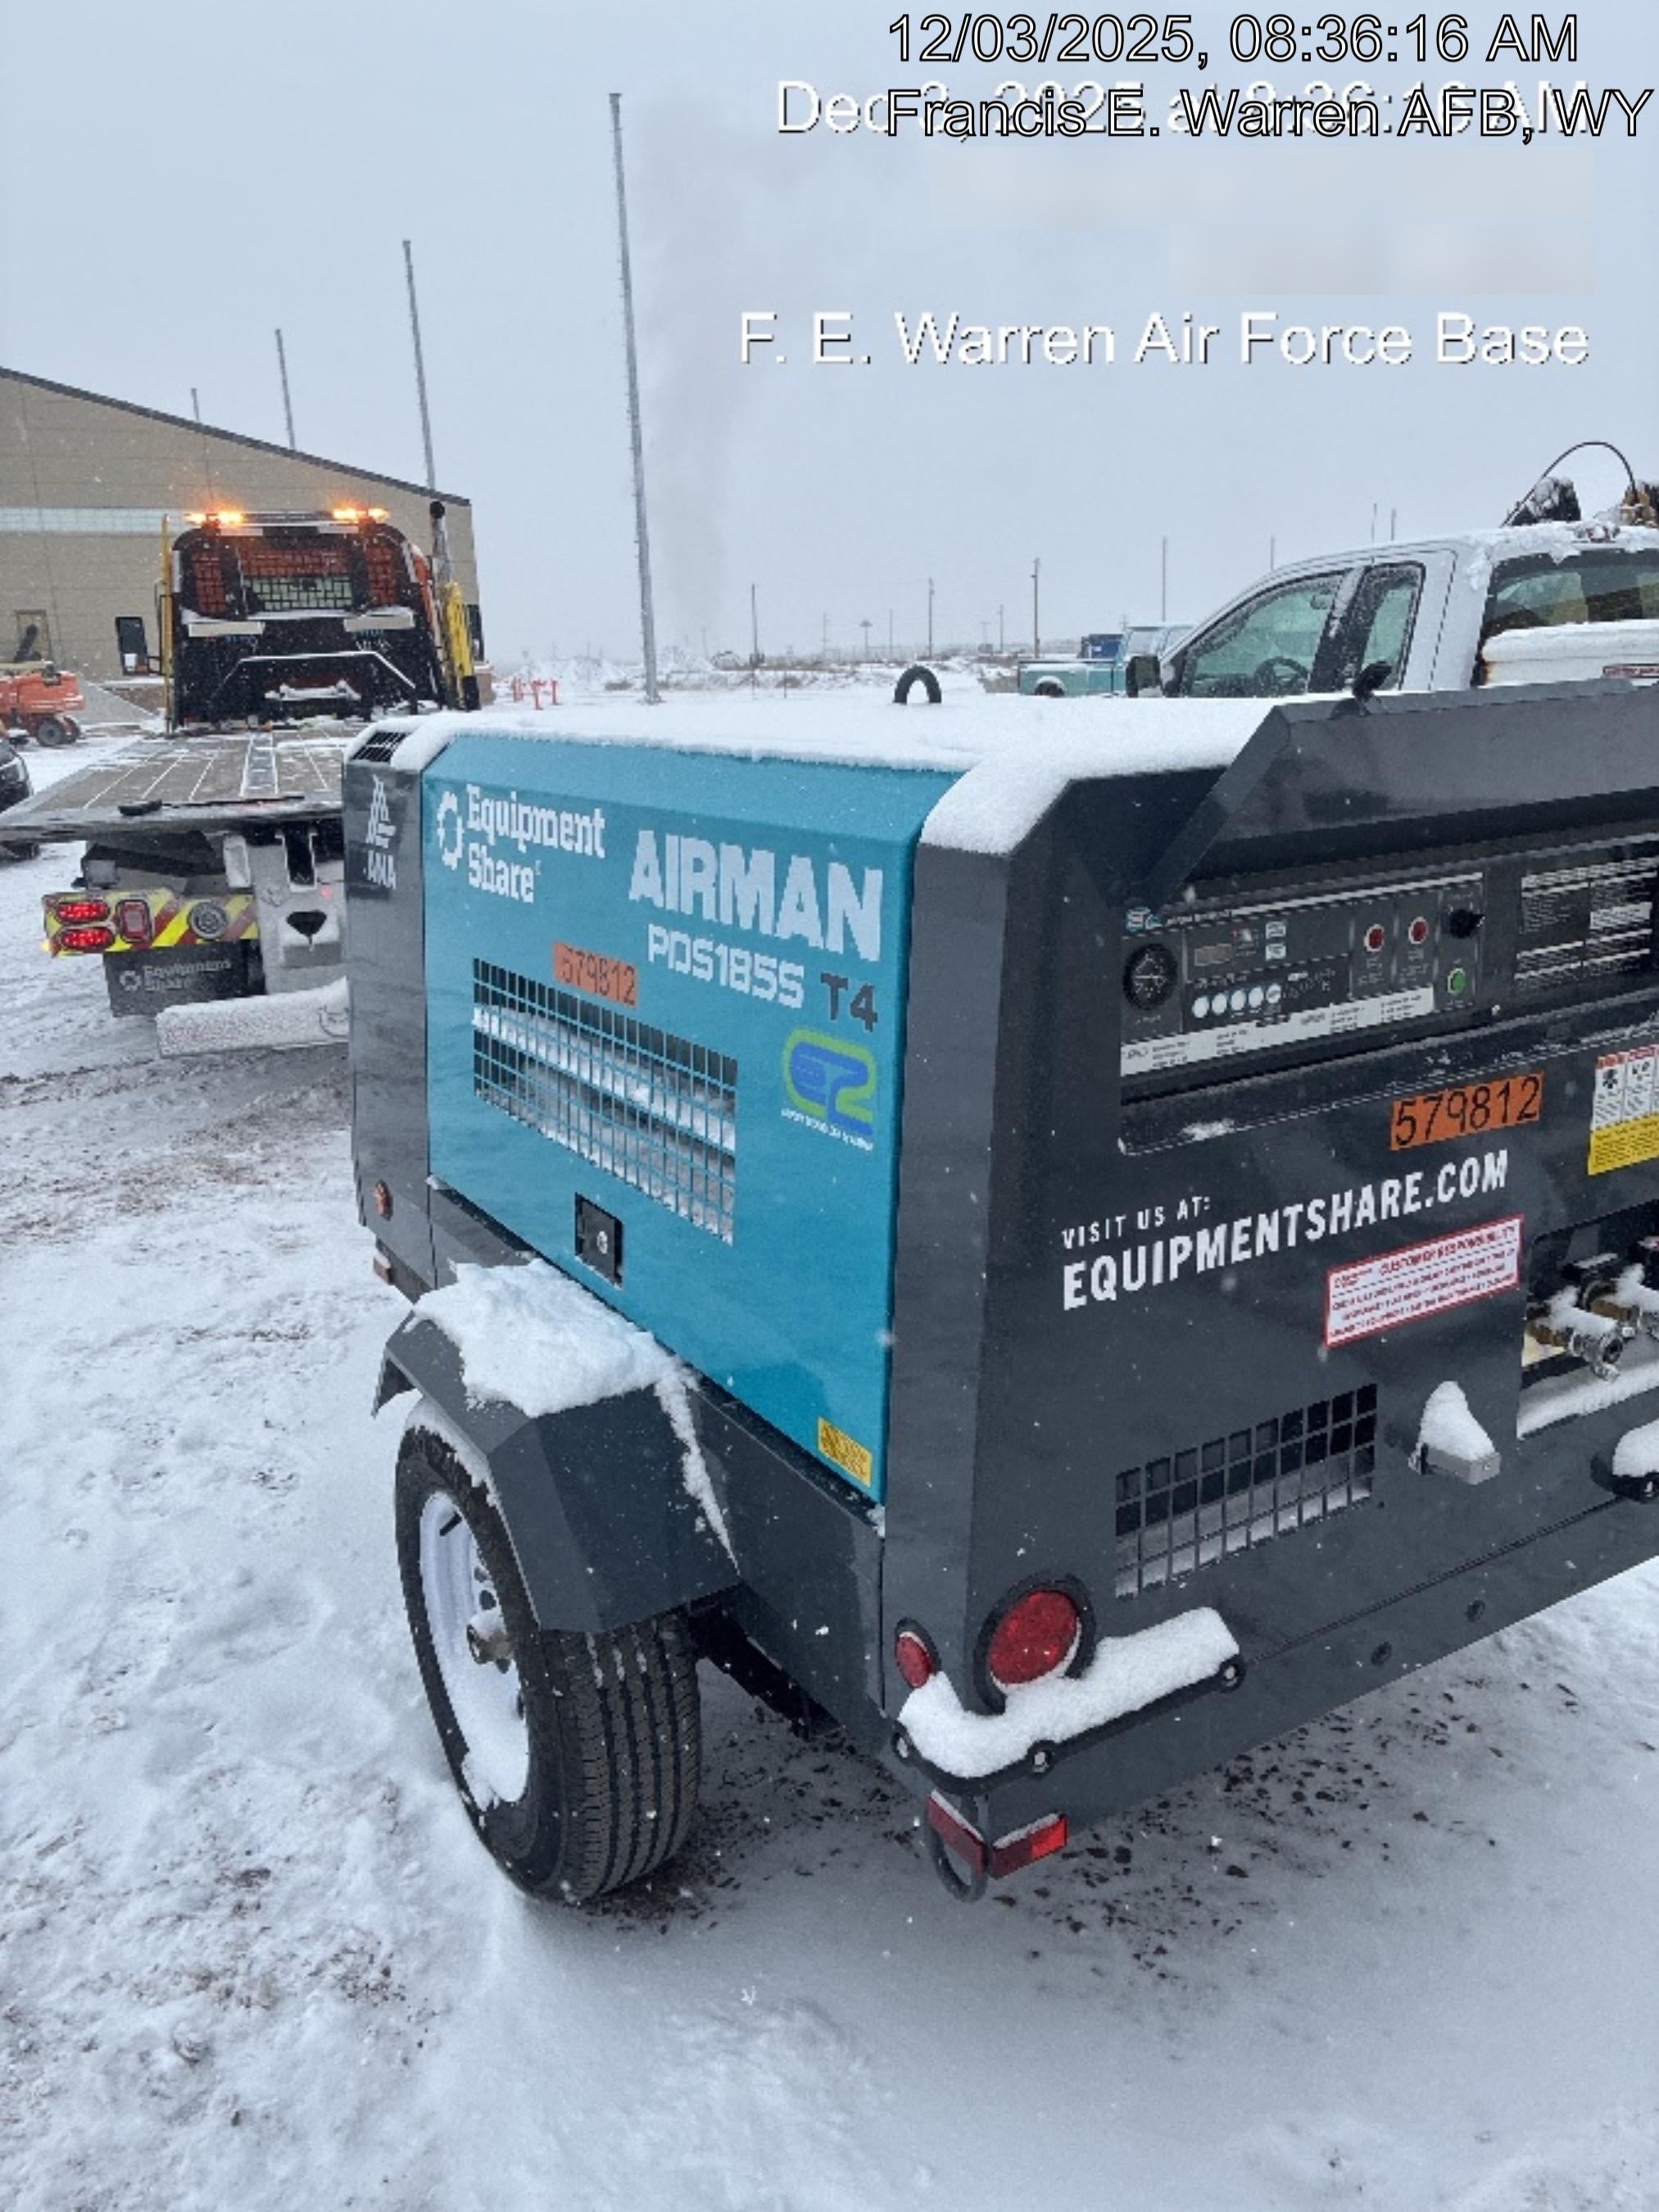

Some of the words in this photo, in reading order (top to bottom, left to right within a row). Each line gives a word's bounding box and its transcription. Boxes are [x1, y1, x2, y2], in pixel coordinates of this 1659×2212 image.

[465, 783, 605, 859] Equipment
[468, 842, 534, 904] Share
[628, 829, 883, 963] AIRMAN
[561, 944, 636, 1007] 579812
[647, 922, 805, 1009] PDS185S
[820, 972, 879, 1033] T4
[1395, 1076, 1540, 1146] 579812
[1062, 1213, 1127, 1249] VISIT
[1137, 1205, 1167, 1231] US
[1176, 1195, 1211, 1222] AT:
[1063, 1149, 1508, 1312] EQUIPMENTSHARE.COM
